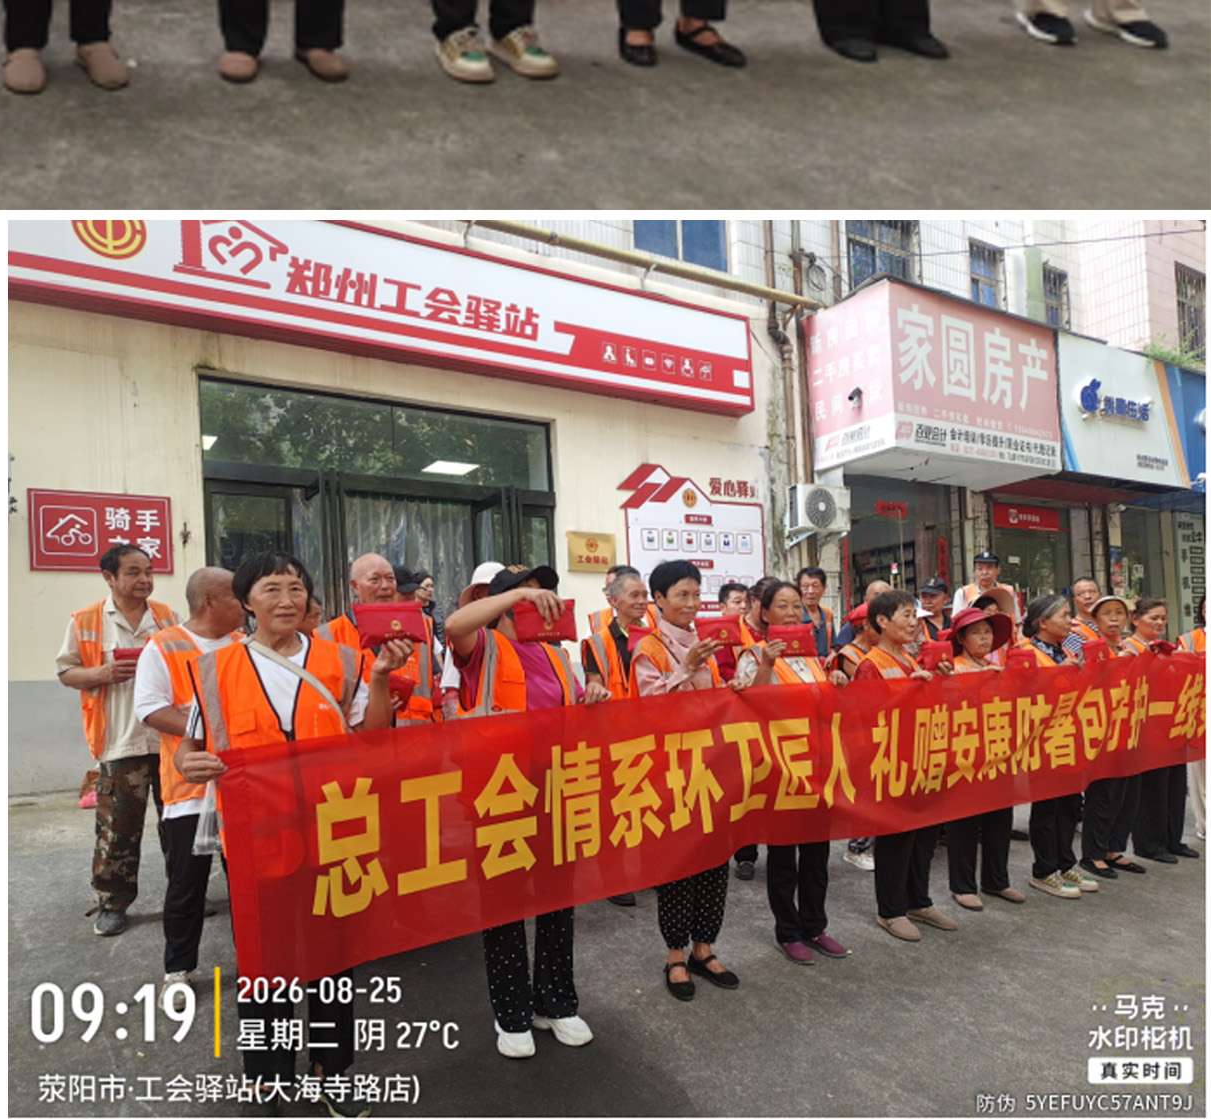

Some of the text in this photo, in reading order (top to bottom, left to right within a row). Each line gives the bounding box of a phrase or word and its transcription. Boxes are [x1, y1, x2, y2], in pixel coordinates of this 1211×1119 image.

[286, 255, 540, 341] 郑州工会驿站
[895, 305, 1048, 412] 家圆房产
[104, 506, 161, 531] 骑手
[312, 674, 1206, 918] 总工会情系环卫匠人 礼赠安康防暑包守护一线
